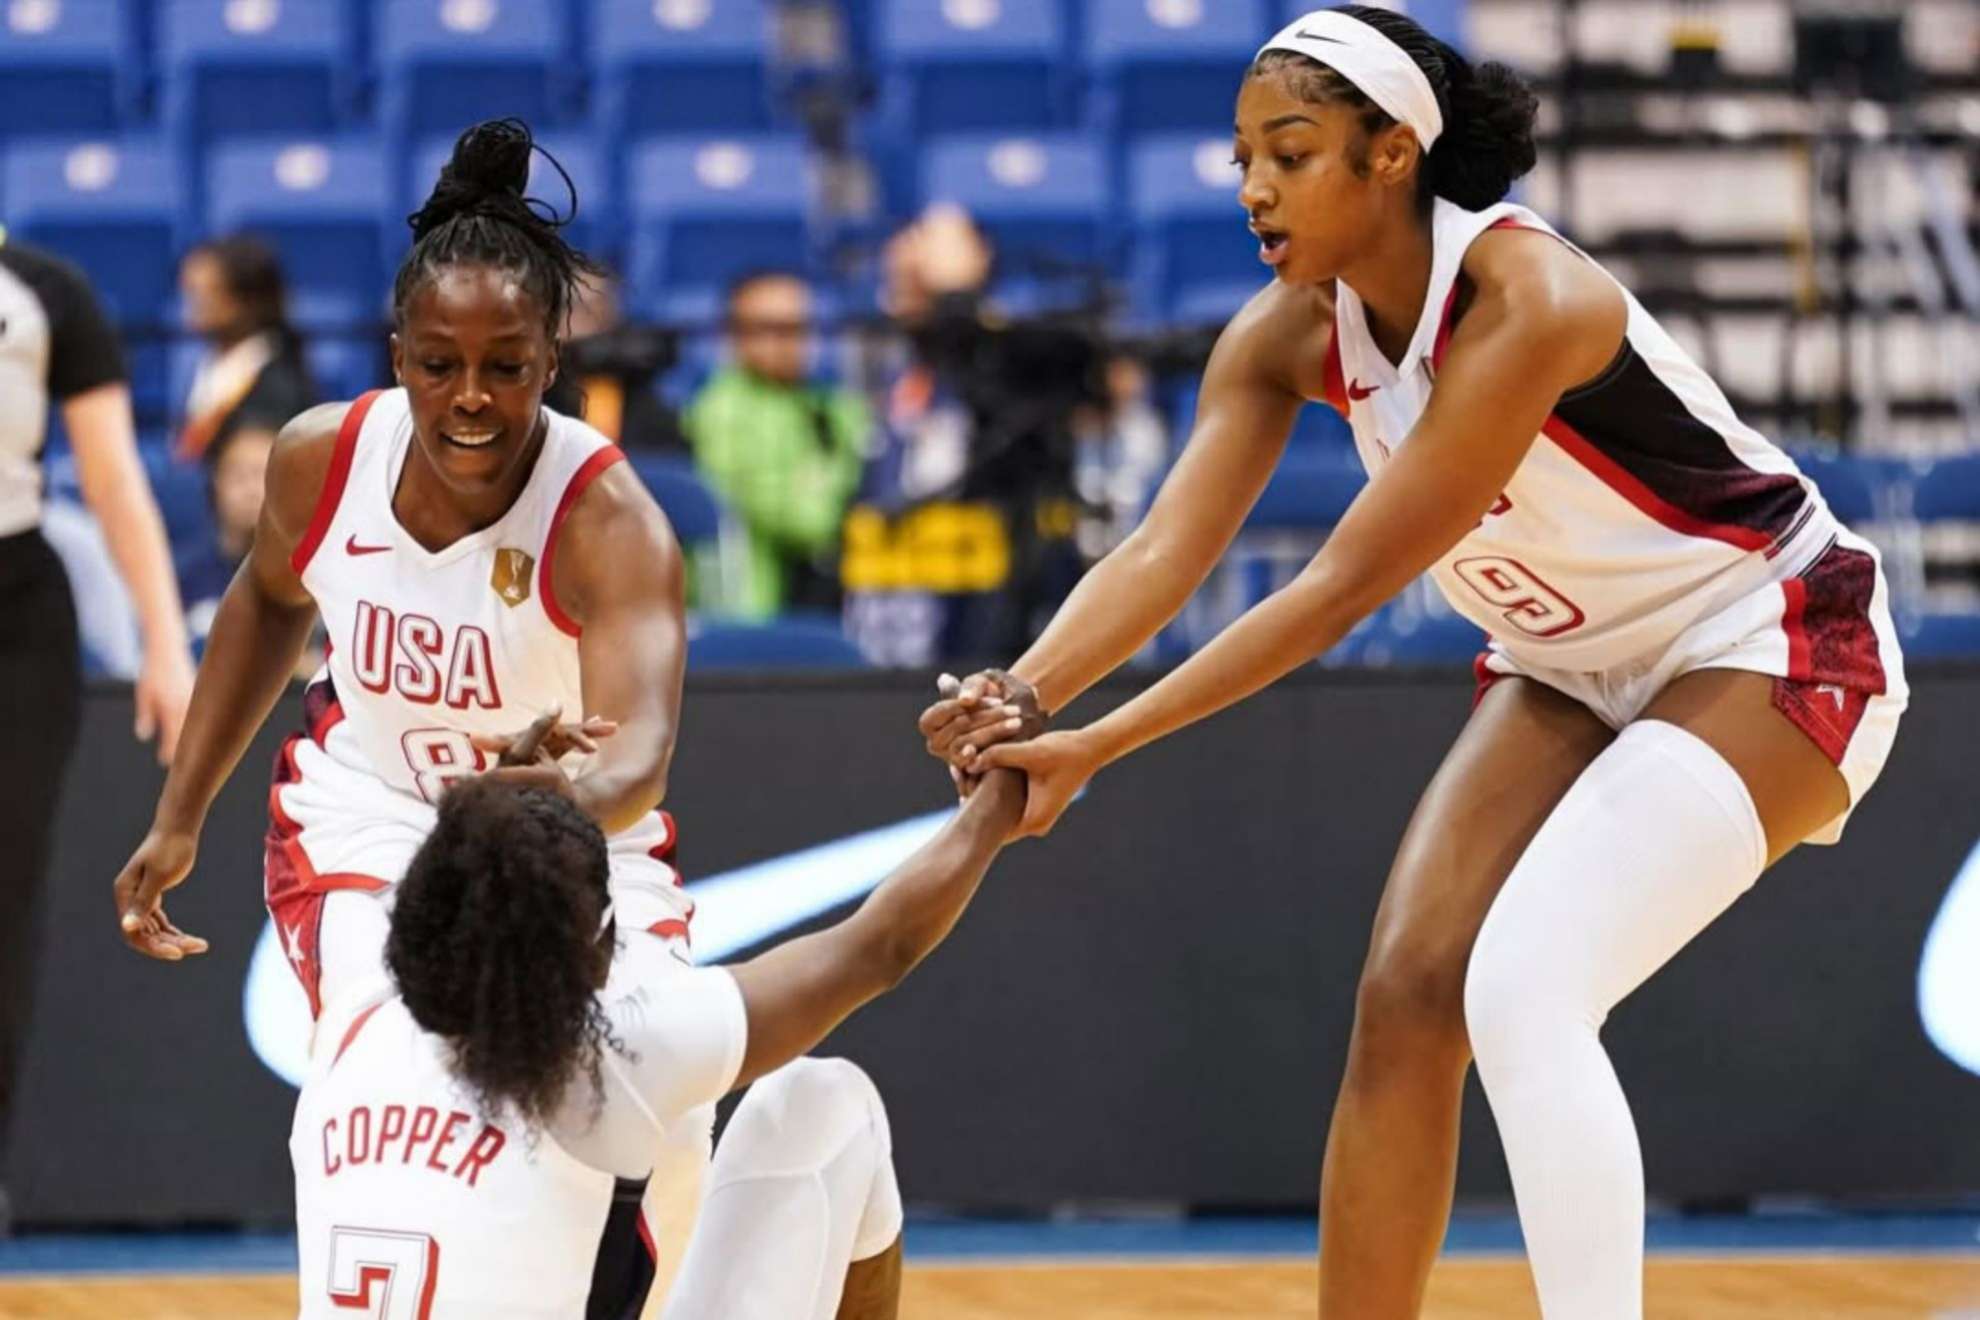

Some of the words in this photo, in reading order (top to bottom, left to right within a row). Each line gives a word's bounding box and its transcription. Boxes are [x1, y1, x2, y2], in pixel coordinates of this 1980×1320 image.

[1453, 555, 1586, 637] 9
[353, 599, 502, 709] USA
[322, 1104, 507, 1188] COPPER
